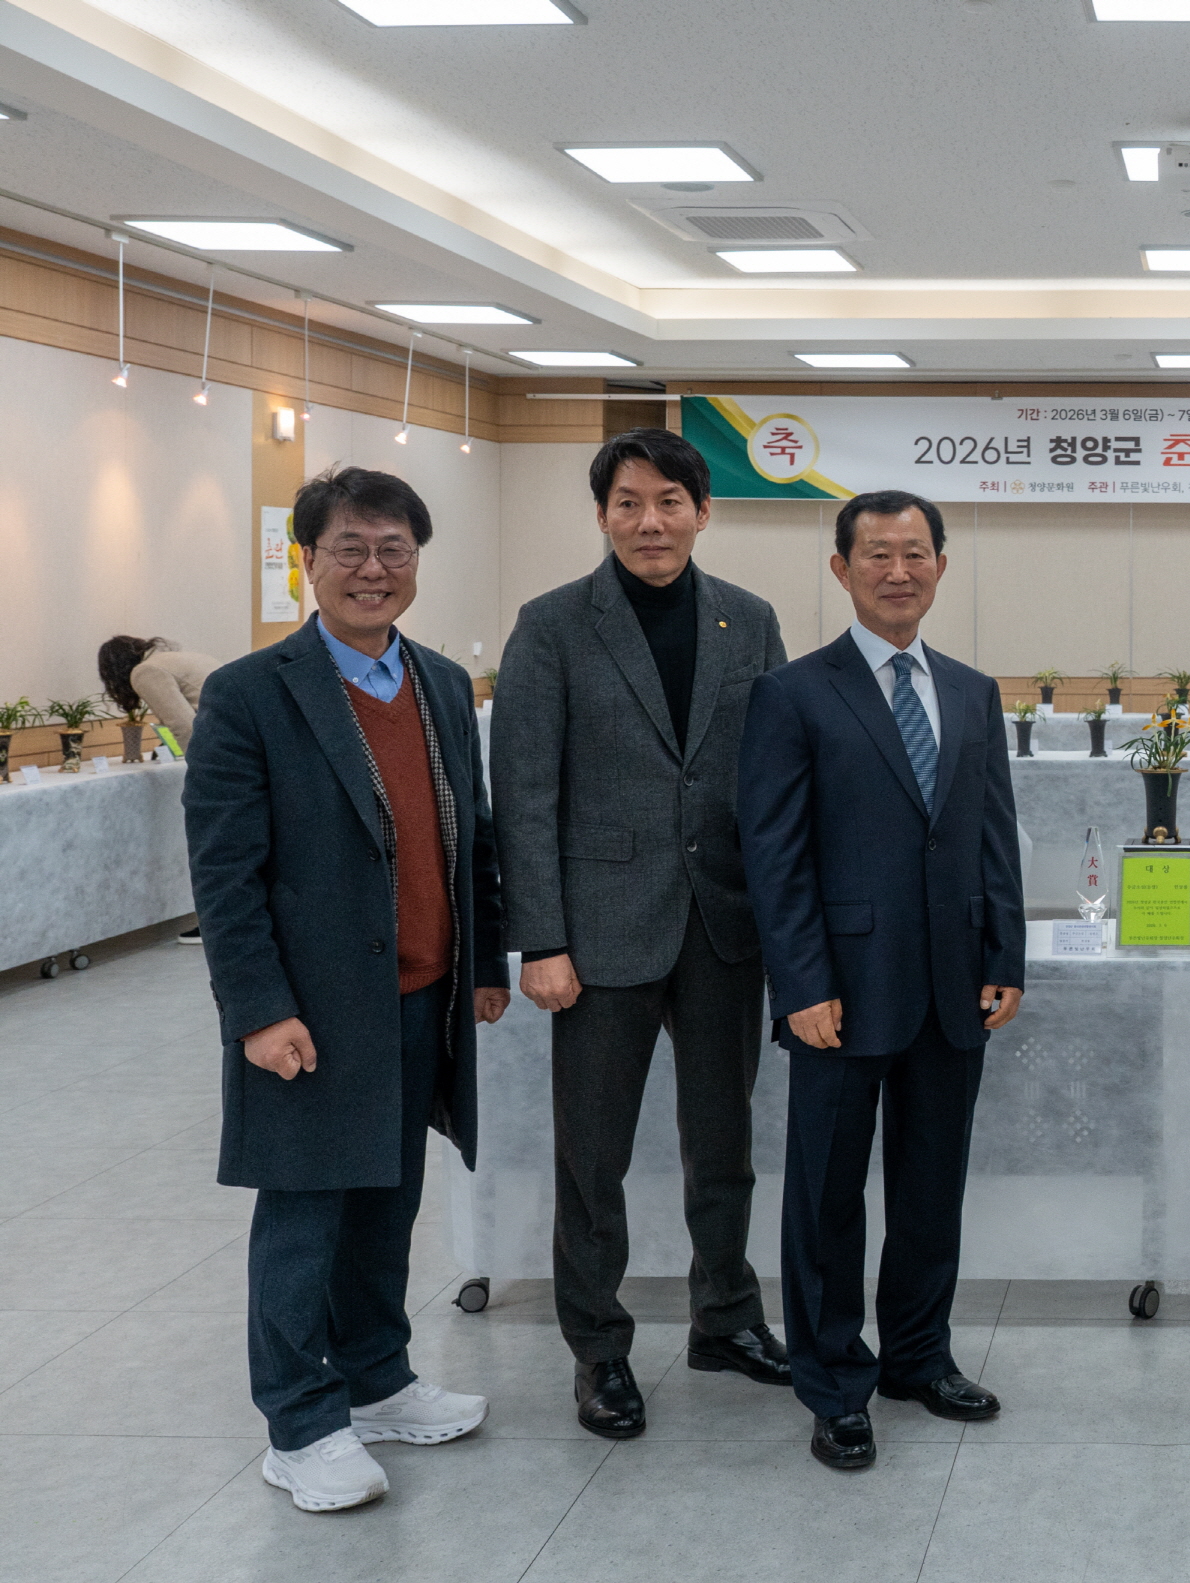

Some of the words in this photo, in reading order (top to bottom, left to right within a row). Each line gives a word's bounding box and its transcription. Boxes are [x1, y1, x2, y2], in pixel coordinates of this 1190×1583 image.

[1017, 408, 1040, 421] 기간
[1051, 408, 1097, 422] 2026년
[1100, 408, 1119, 422] 3월
[1123, 408, 1164, 422] 6일(금)
[763, 427, 804, 466] 축
[914, 435, 1032, 466] 2026년
[1048, 435, 1143, 466] 청양군
[979, 481, 1000, 493] 주최
[1028, 482, 1074, 493] 청양문화원
[1087, 481, 1109, 493] 주관
[1119, 481, 1184, 494] 푸른빛난우회,
